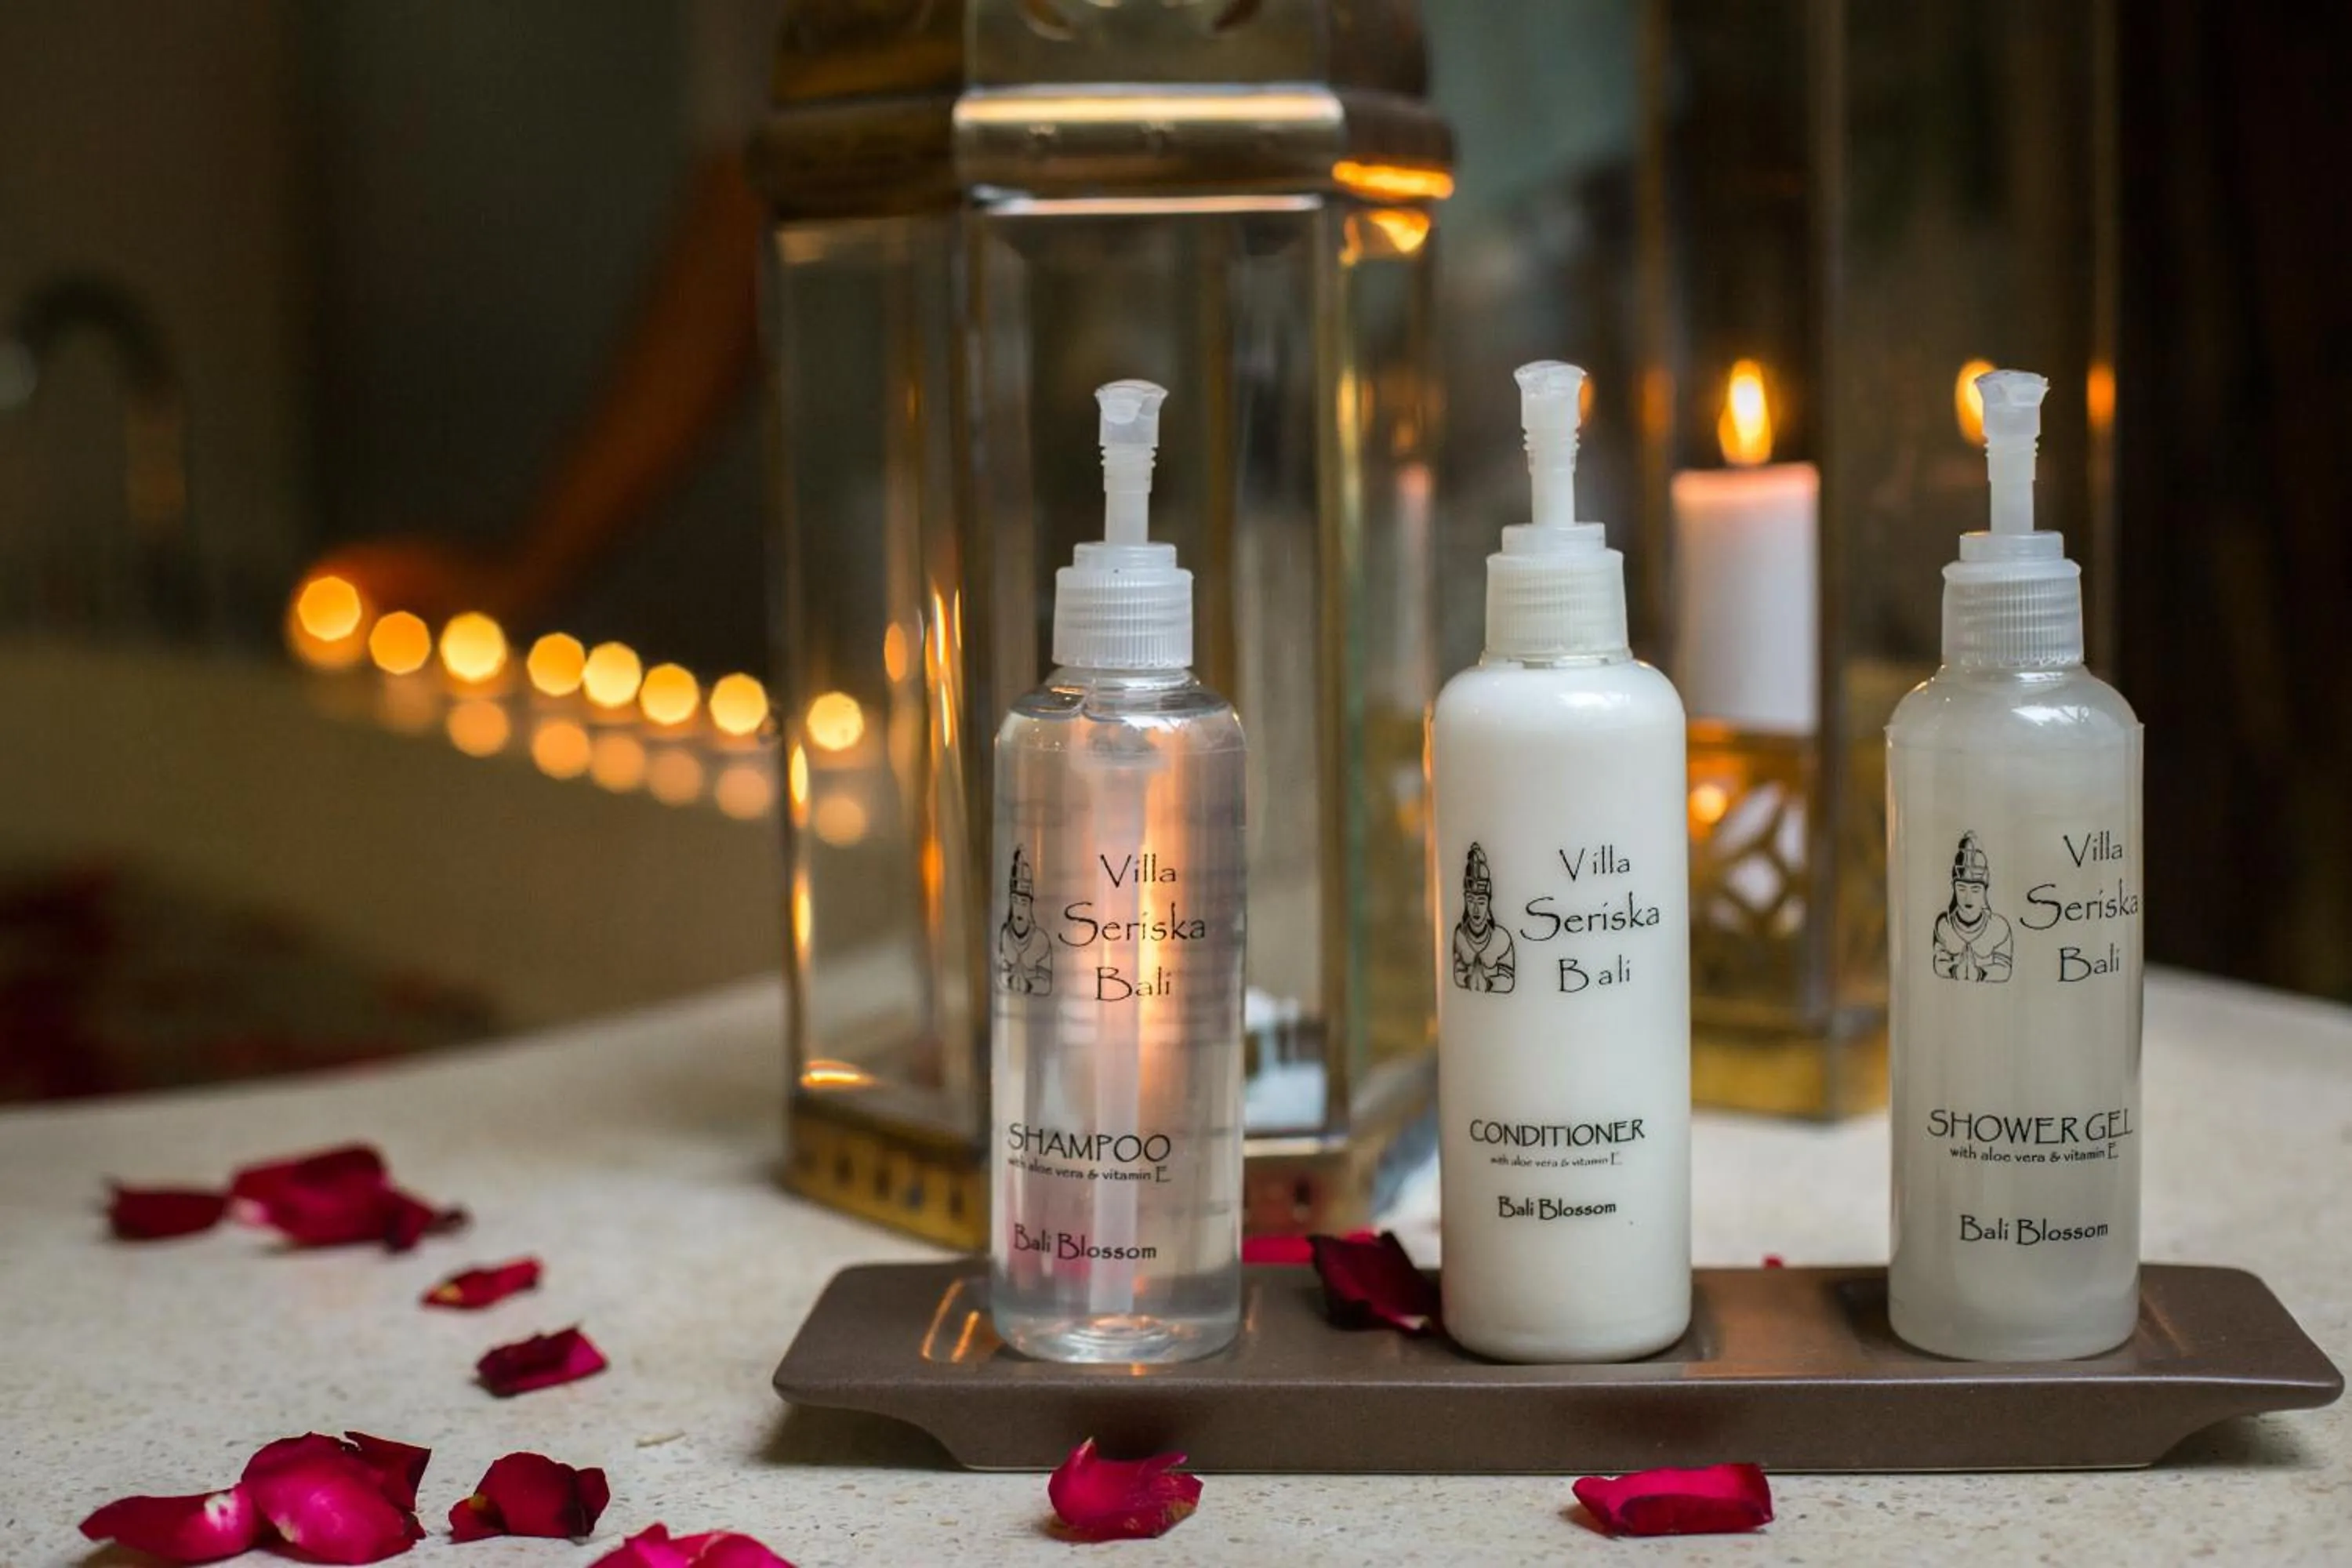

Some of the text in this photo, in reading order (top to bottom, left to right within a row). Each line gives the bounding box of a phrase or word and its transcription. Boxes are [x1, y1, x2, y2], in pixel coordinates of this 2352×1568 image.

[1559, 844, 1631, 882] Villa
[2063, 830, 2122, 867] Villa
[1099, 853, 1176, 889] Villa
[1519, 891, 1660, 942] Seriska
[2020, 878, 2138, 930] Seriska
[1058, 902, 1206, 947] Seriska
[1558, 954, 1631, 993] Bali
[2058, 942, 2120, 982] Bali
[1094, 966, 1174, 1002] Bali
[1007, 1123, 1171, 1163] SHAMPOO
[1469, 1119, 1646, 1147] CONDITIONER
[1927, 1108, 2133, 1144] SHOWER GEL
[1028, 1158, 1054, 1175] aloe
[1055, 1167, 1083, 1179] vera
[1087, 1169, 1098, 1180] &
[1102, 1167, 1151, 1181] vitamin
[1155, 1165, 1172, 1183] E
[1490, 1156, 1509, 1165] with
[1511, 1156, 1532, 1167] aloe
[1535, 1159, 1558, 1168] vera
[1560, 1158, 1569, 1167] &
[1571, 1156, 1608, 1167] vitamin
[1950, 1142, 2118, 1163] with aloe vera & vitamin E
[1497, 1195, 1617, 1220] Bali Blossom
[1014, 1223, 1156, 1260] Bali Blossom
[1960, 1214, 2108, 1246] Bali Blossom
